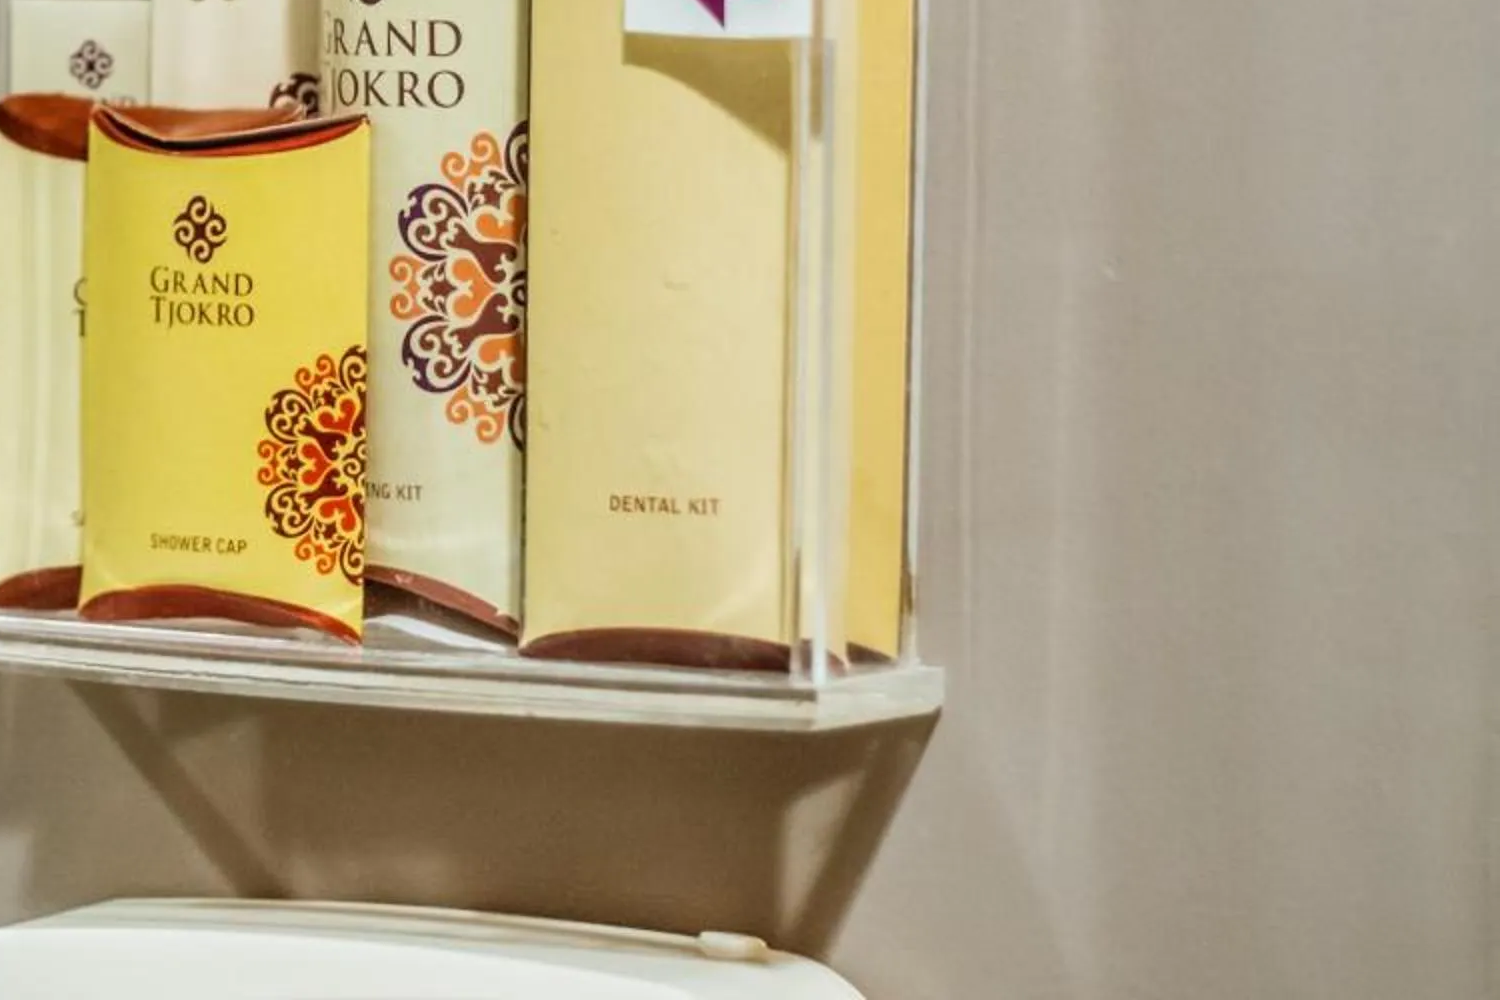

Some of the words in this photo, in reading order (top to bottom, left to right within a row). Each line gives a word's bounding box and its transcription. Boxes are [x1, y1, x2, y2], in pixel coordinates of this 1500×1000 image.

[323, 60, 466, 114] JOKRO
[150, 265, 254, 298] GRAND
[149, 296, 256, 332] TJOKRO
[364, 481, 391, 499] ING
[396, 484, 423, 501] KIT
[608, 494, 682, 515] DENTAL
[687, 498, 721, 516] KIT
[150, 533, 212, 553] SHOWER
[216, 537, 247, 555] CAP
